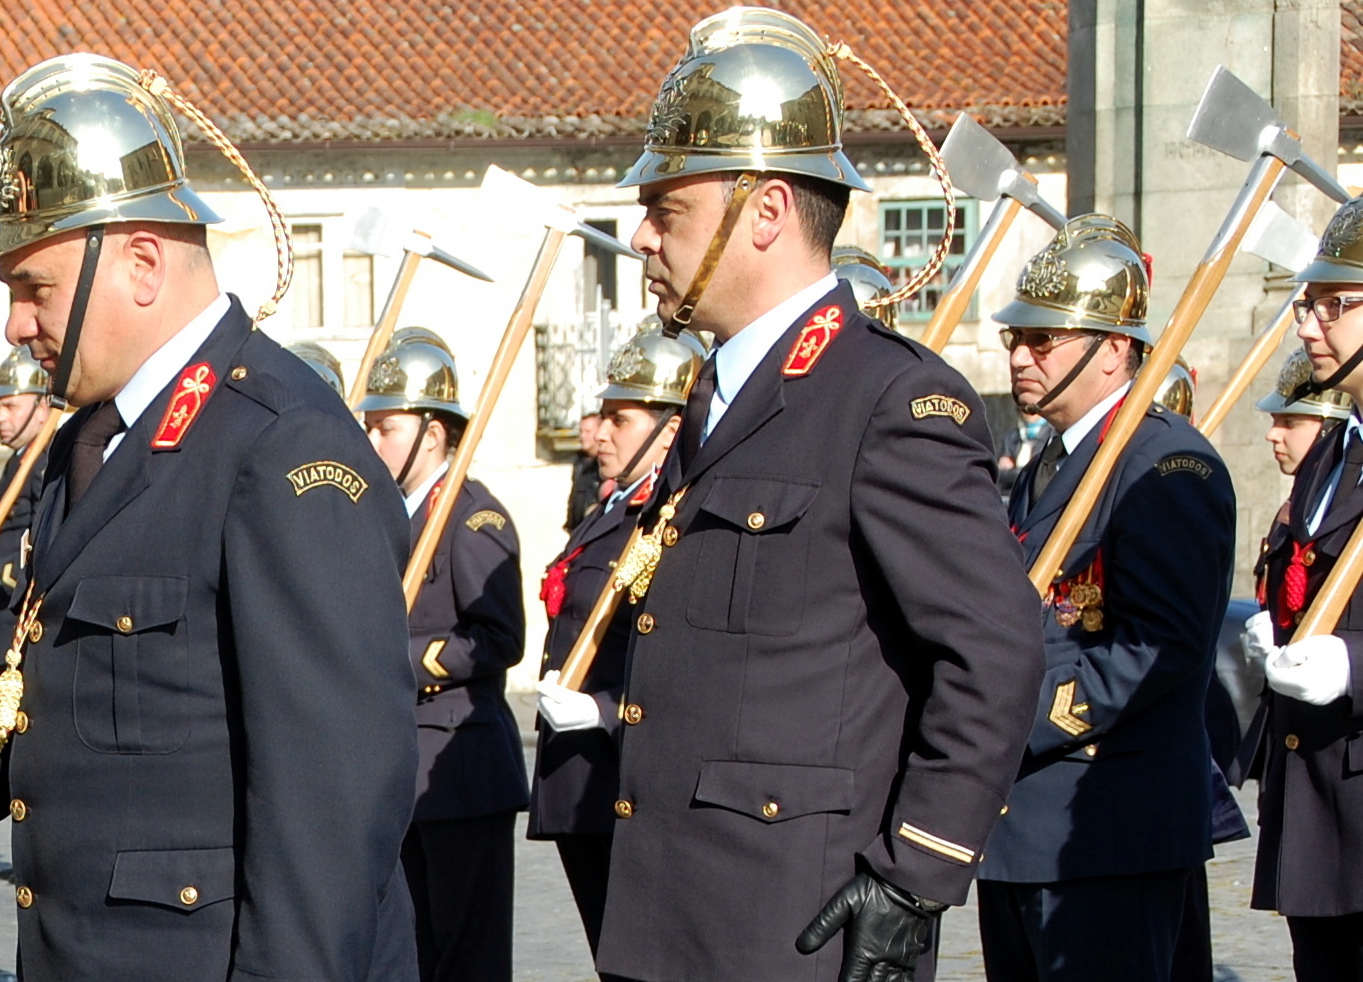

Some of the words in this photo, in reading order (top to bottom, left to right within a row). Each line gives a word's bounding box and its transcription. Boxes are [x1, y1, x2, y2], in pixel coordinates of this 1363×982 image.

[913, 400, 965, 420] VIATODOS
[1159, 458, 1208, 476] VIATODOS
[293, 466, 360, 493] VIATODOS
